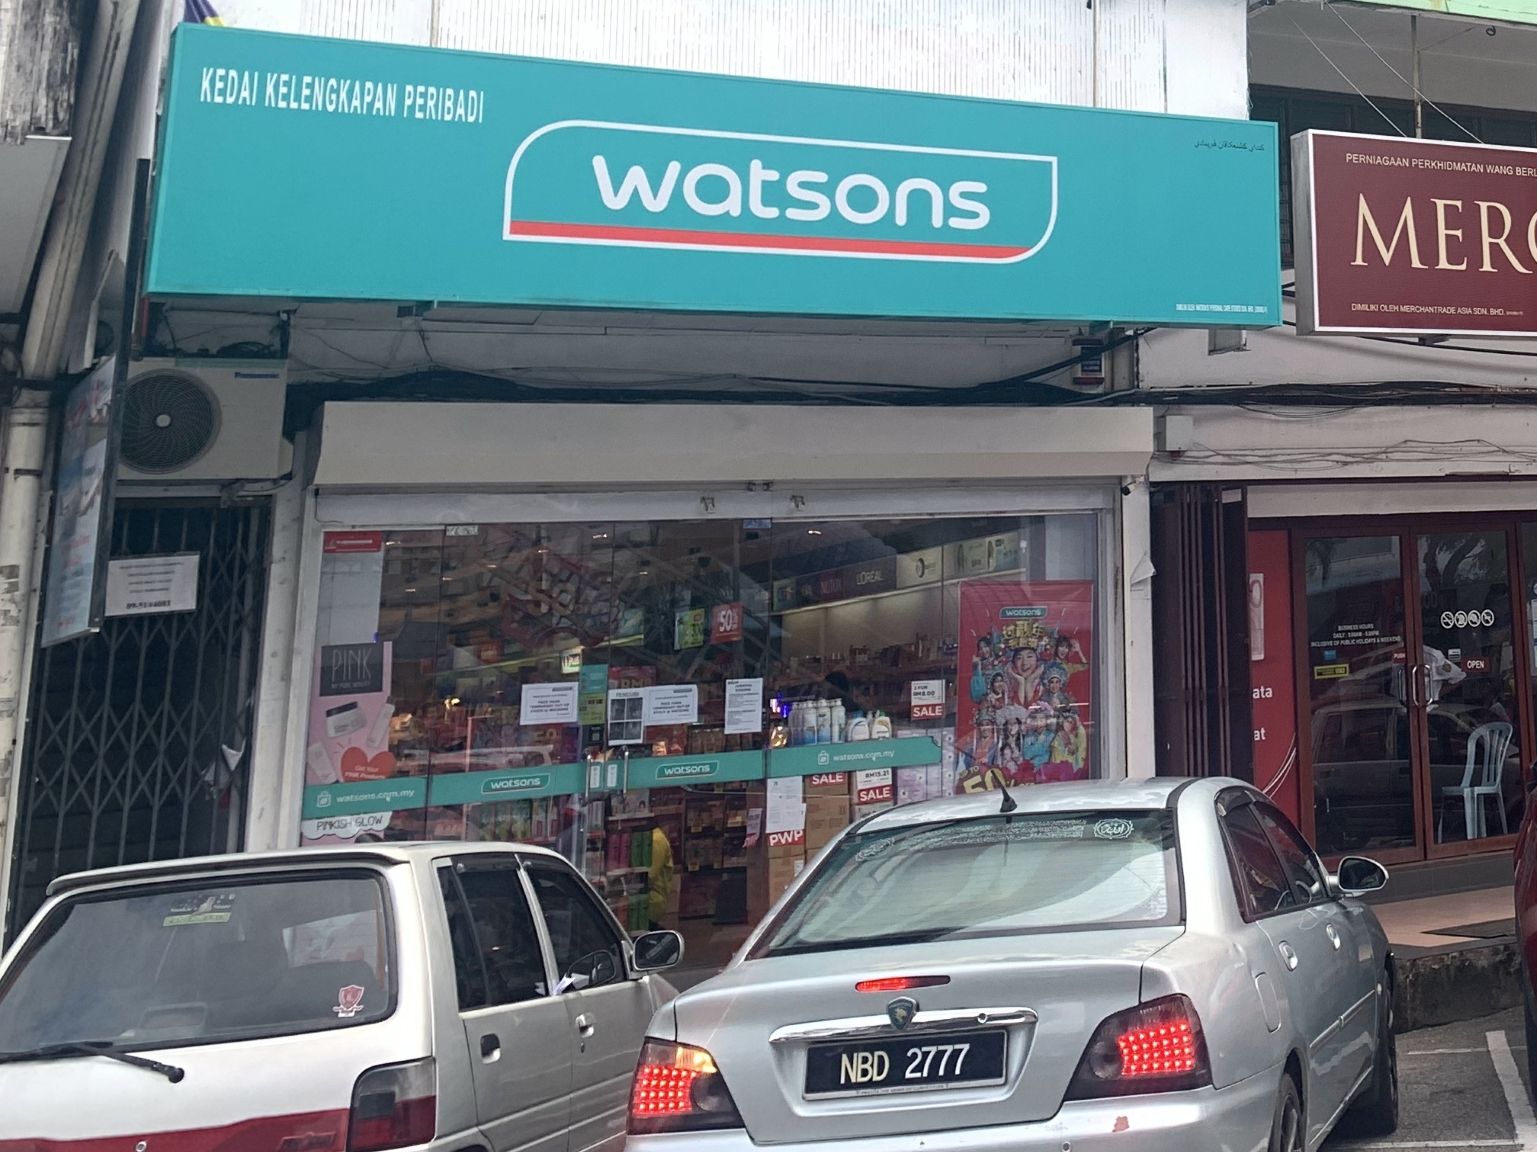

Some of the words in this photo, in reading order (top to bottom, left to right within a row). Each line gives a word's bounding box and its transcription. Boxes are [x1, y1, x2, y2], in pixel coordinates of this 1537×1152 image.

[201, 67, 259, 106] KEDAI
[265, 72, 398, 117] KELENGKAPAN
[403, 85, 485, 124] PERIBADI
[1346, 153, 1409, 167] PERNIAGAAN
[1411, 159, 1484, 174] PERKHIDMATAN
[1486, 164, 1514, 176] WANG
[592, 154, 991, 231] watsons
[1352, 303, 1379, 312] DIMILIKI
[1380, 304, 1399, 313] OLEH
[1400, 305, 1456, 315] MERCHANTRADE
[1457, 307, 1473, 315] ASIA
[331, 649, 372, 682] PINK
[1466, 660, 1485, 669] OPEN
[913, 705, 943, 717] SALE
[833, 749, 895, 761] watsons.com.my
[663, 761, 712, 777] watsons
[969, 765, 979, 774] TO
[489, 774, 543, 792] watsons
[811, 772, 844, 786] SALE
[335, 789, 415, 803] watsons.com.my
[859, 787, 892, 802] SALE
[769, 831, 803, 847] PWP
[840, 1050, 890, 1085] NBD
[904, 1043, 970, 1080] 2777
